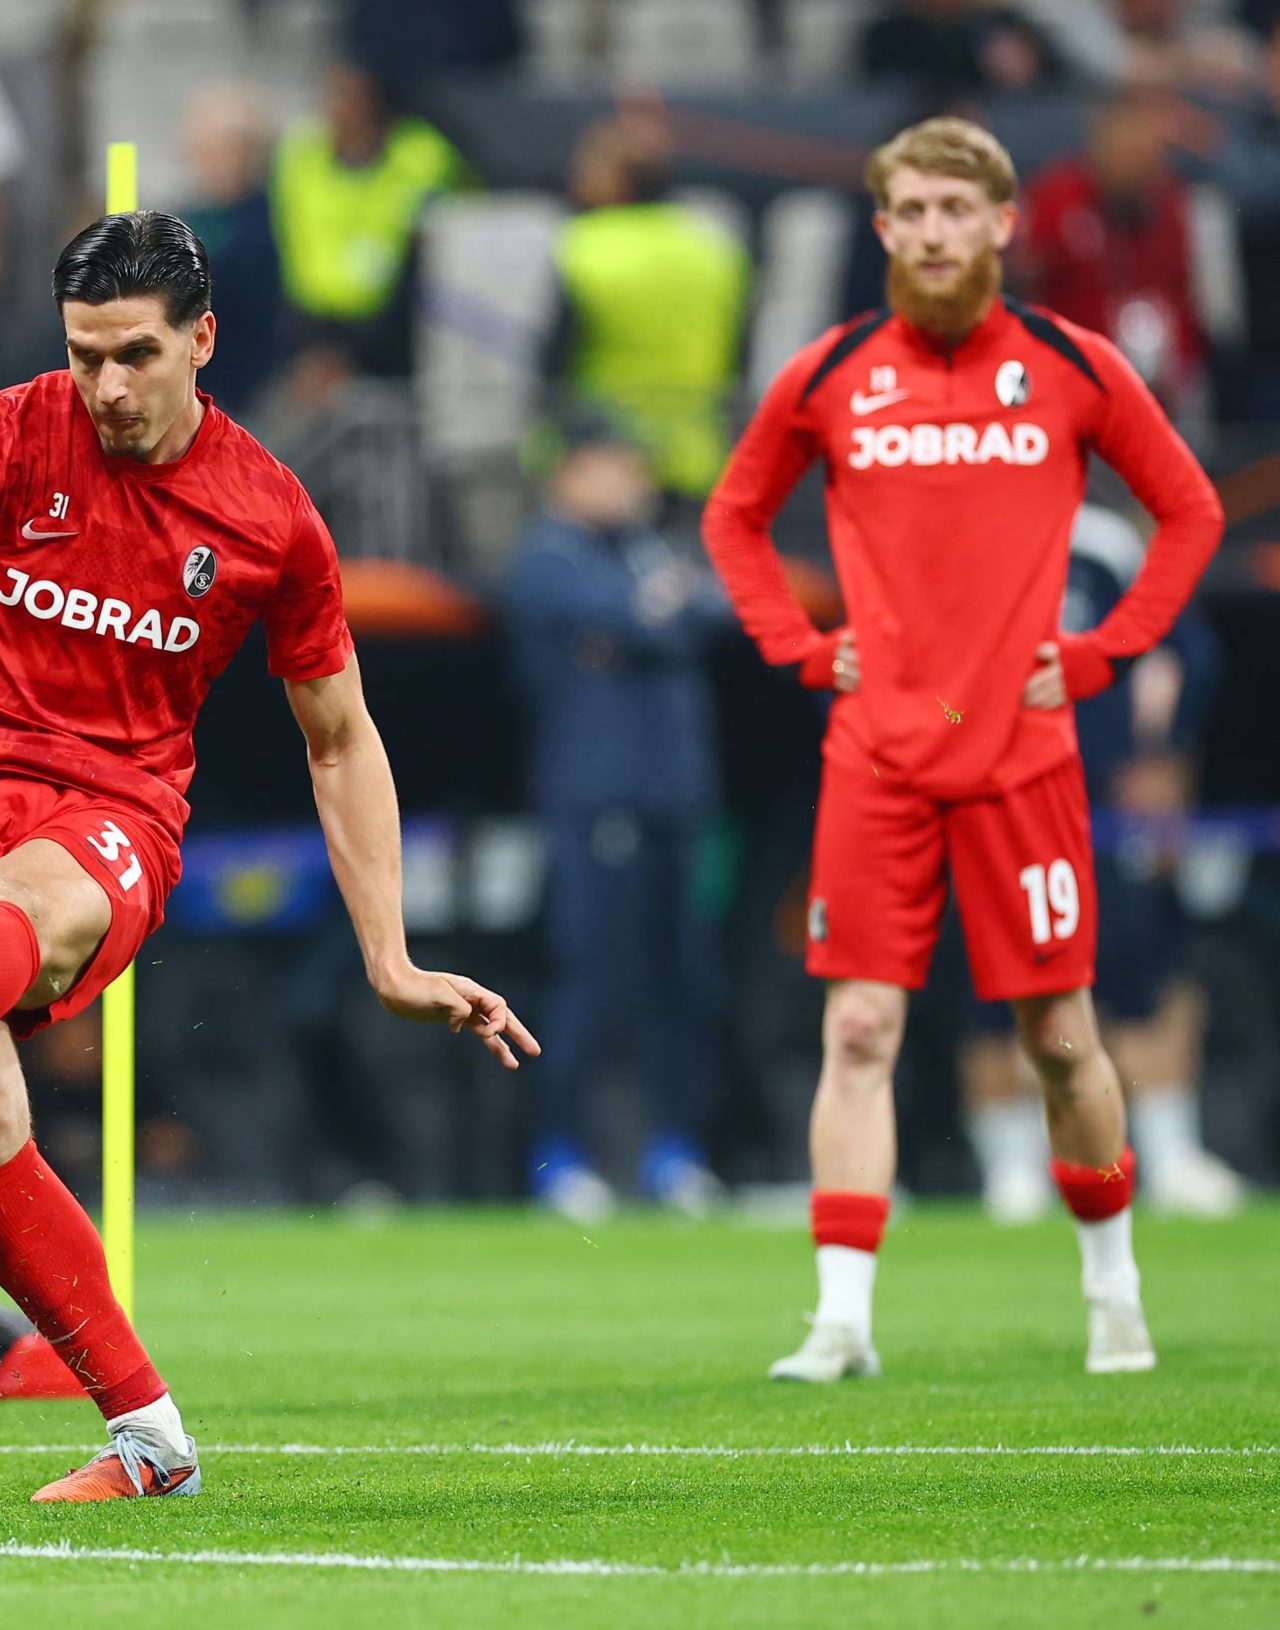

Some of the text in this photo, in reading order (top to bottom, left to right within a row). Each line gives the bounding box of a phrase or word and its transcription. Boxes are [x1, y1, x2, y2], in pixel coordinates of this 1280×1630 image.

[848, 421, 1049, 470] JOBRAD
[49, 492, 70, 520] 31
[87, 820, 144, 892] 31
[1019, 858, 1080, 944] 19
